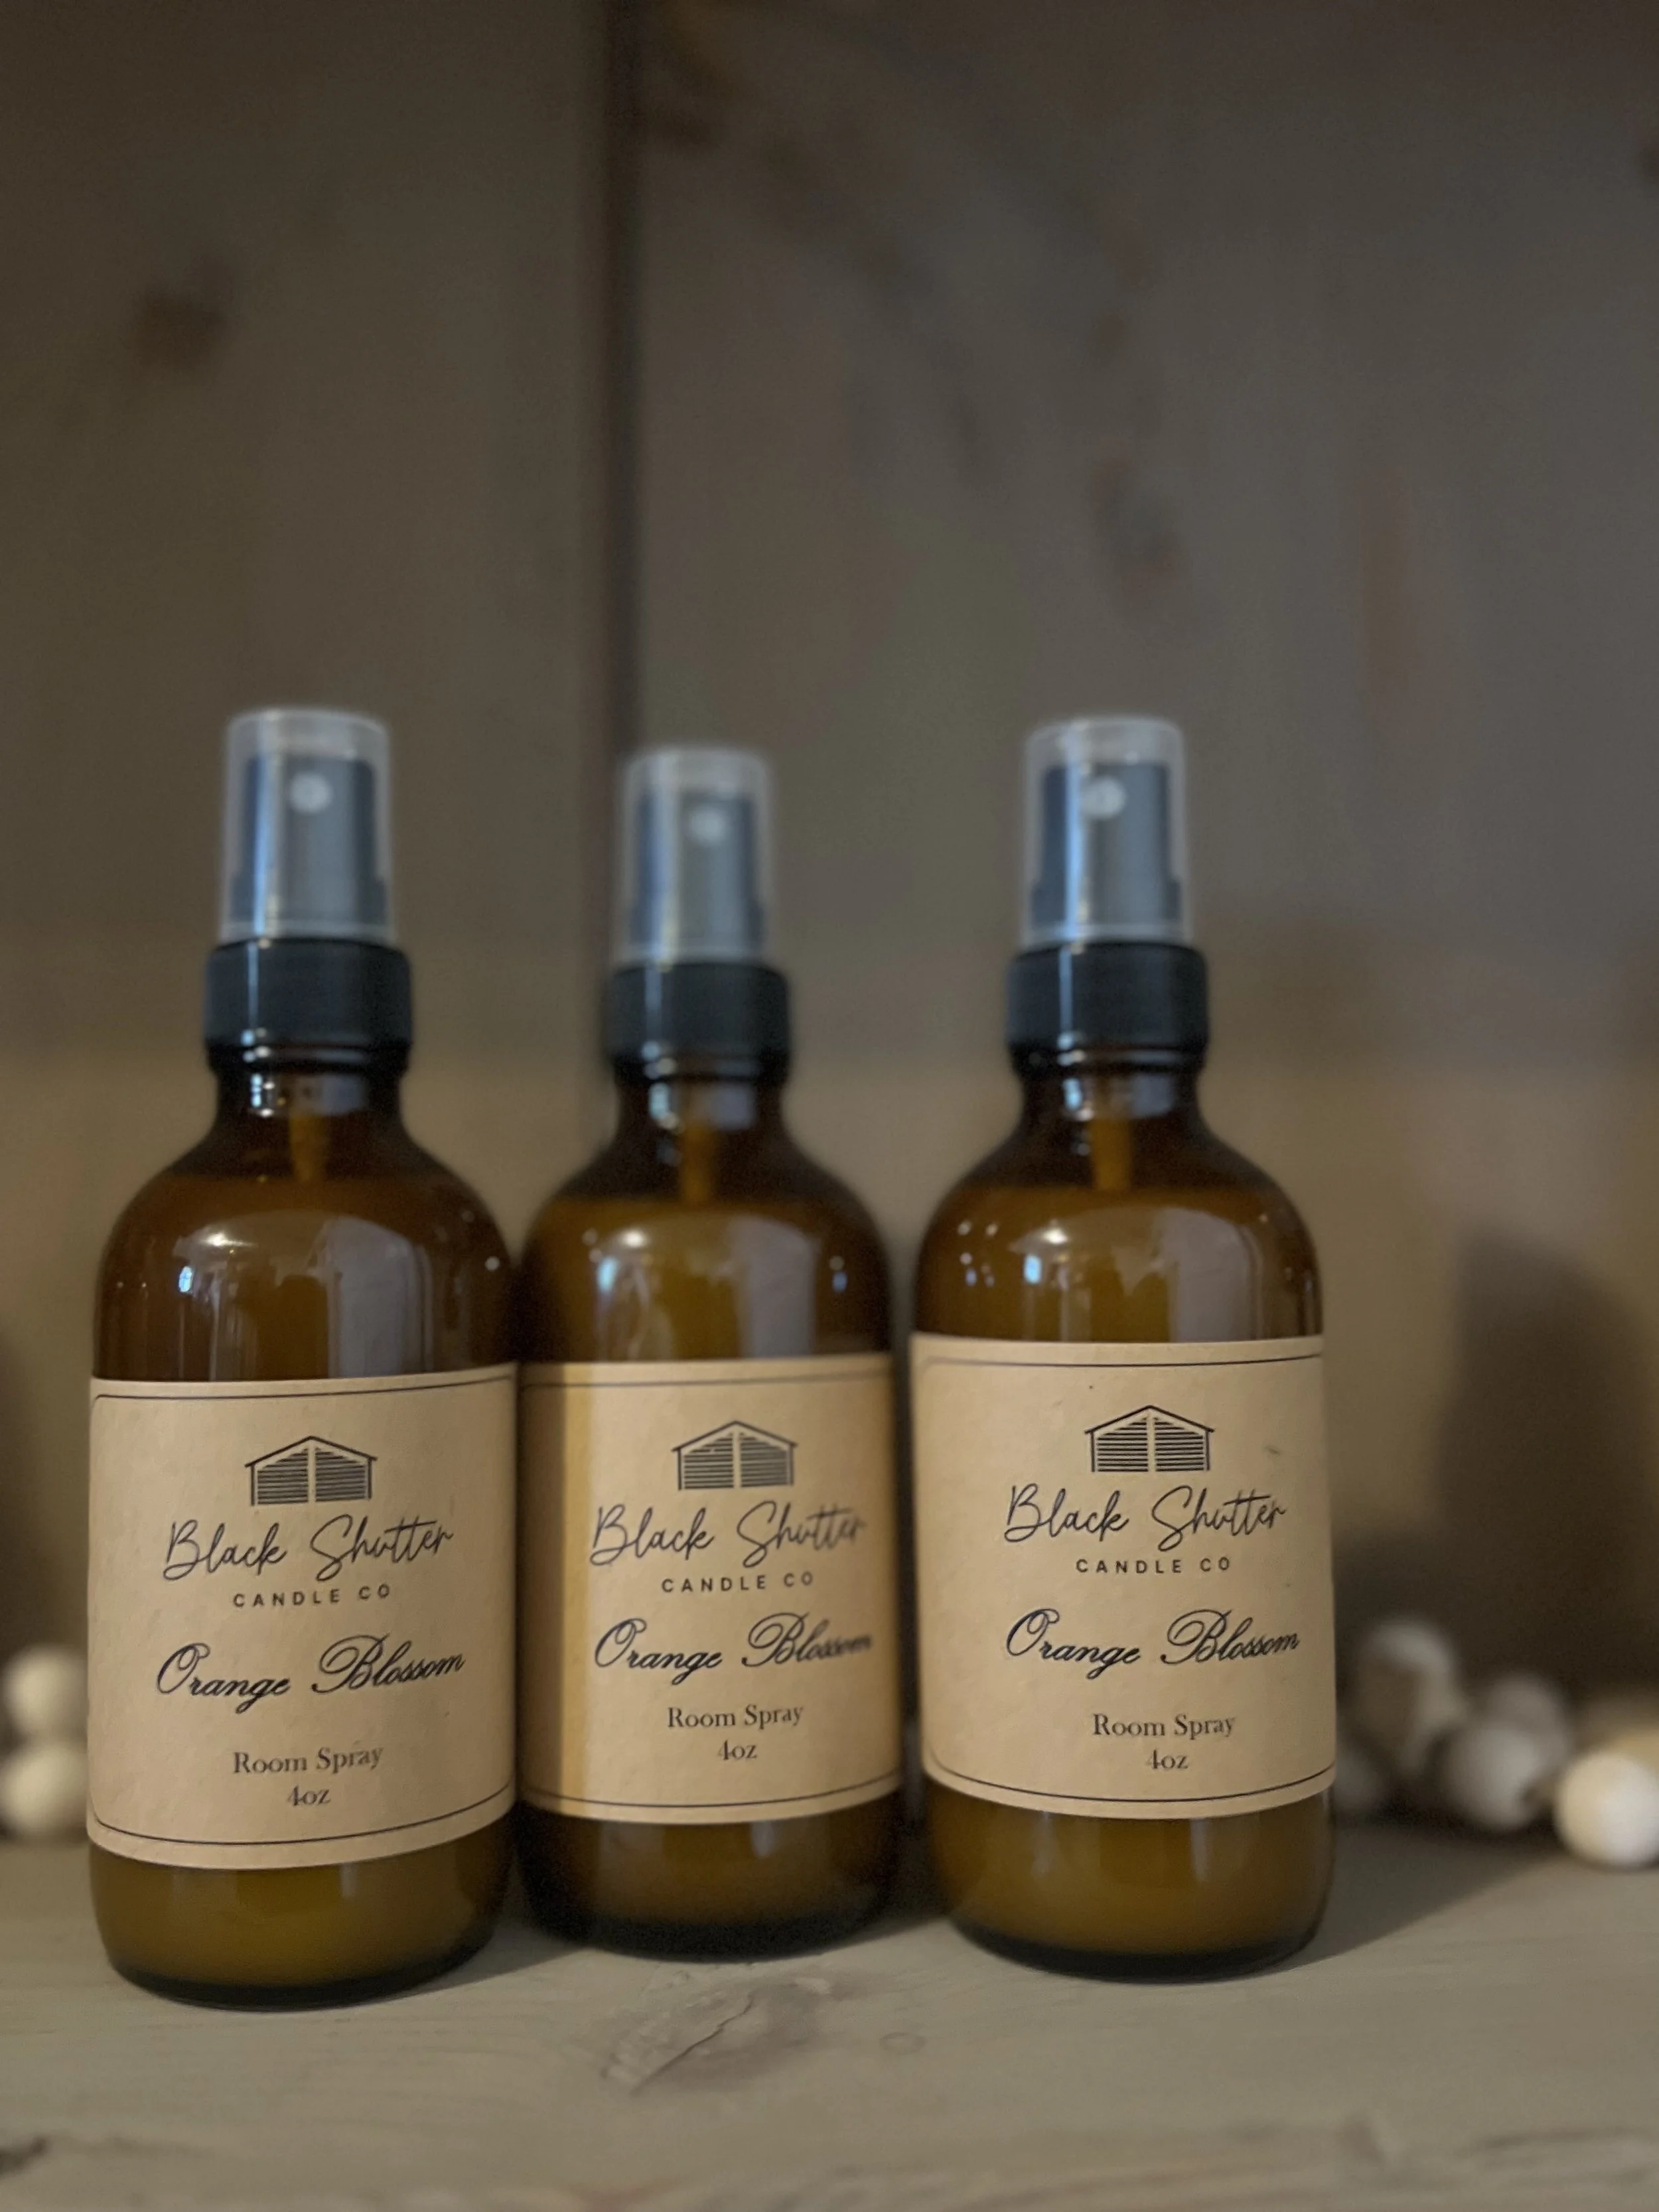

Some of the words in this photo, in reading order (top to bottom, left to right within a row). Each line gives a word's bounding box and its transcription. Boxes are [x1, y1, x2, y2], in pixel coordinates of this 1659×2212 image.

[1004, 1483, 1129, 1543] Black
[1151, 1484, 1286, 1552] Shutter
[590, 1504, 715, 1566] Black
[737, 1500, 865, 1568] Shutter
[163, 1519, 286, 1581] Black
[310, 1514, 454, 1582] Shutter
[1076, 1558, 1182, 1574] CANDLE
[1200, 1556, 1230, 1572] CO
[233, 1588, 340, 1608] CANDLE
[359, 1584, 390, 1600] CO
[662, 1575, 767, 1593] CANDLE
[784, 1572, 814, 1588] CO
[595, 1618, 723, 1685] Orange
[1006, 1608, 1141, 1680] Orange
[1160, 1609, 1300, 1665] Blossom
[156, 1642, 291, 1713] Orange
[311, 1633, 466, 1694] Blossom
[667, 1706, 736, 1728] Room
[744, 1704, 804, 1730] Spray
[1093, 1713, 1166, 1737] Room
[1173, 1713, 1236, 1740] Spray
[233, 1750, 307, 1774] Room
[316, 1746, 384, 1774] Spray
[717, 1740, 758, 1760] 4oz
[1150, 1749, 1189, 1771] 4oz
[287, 1785, 330, 1807] 4oz
